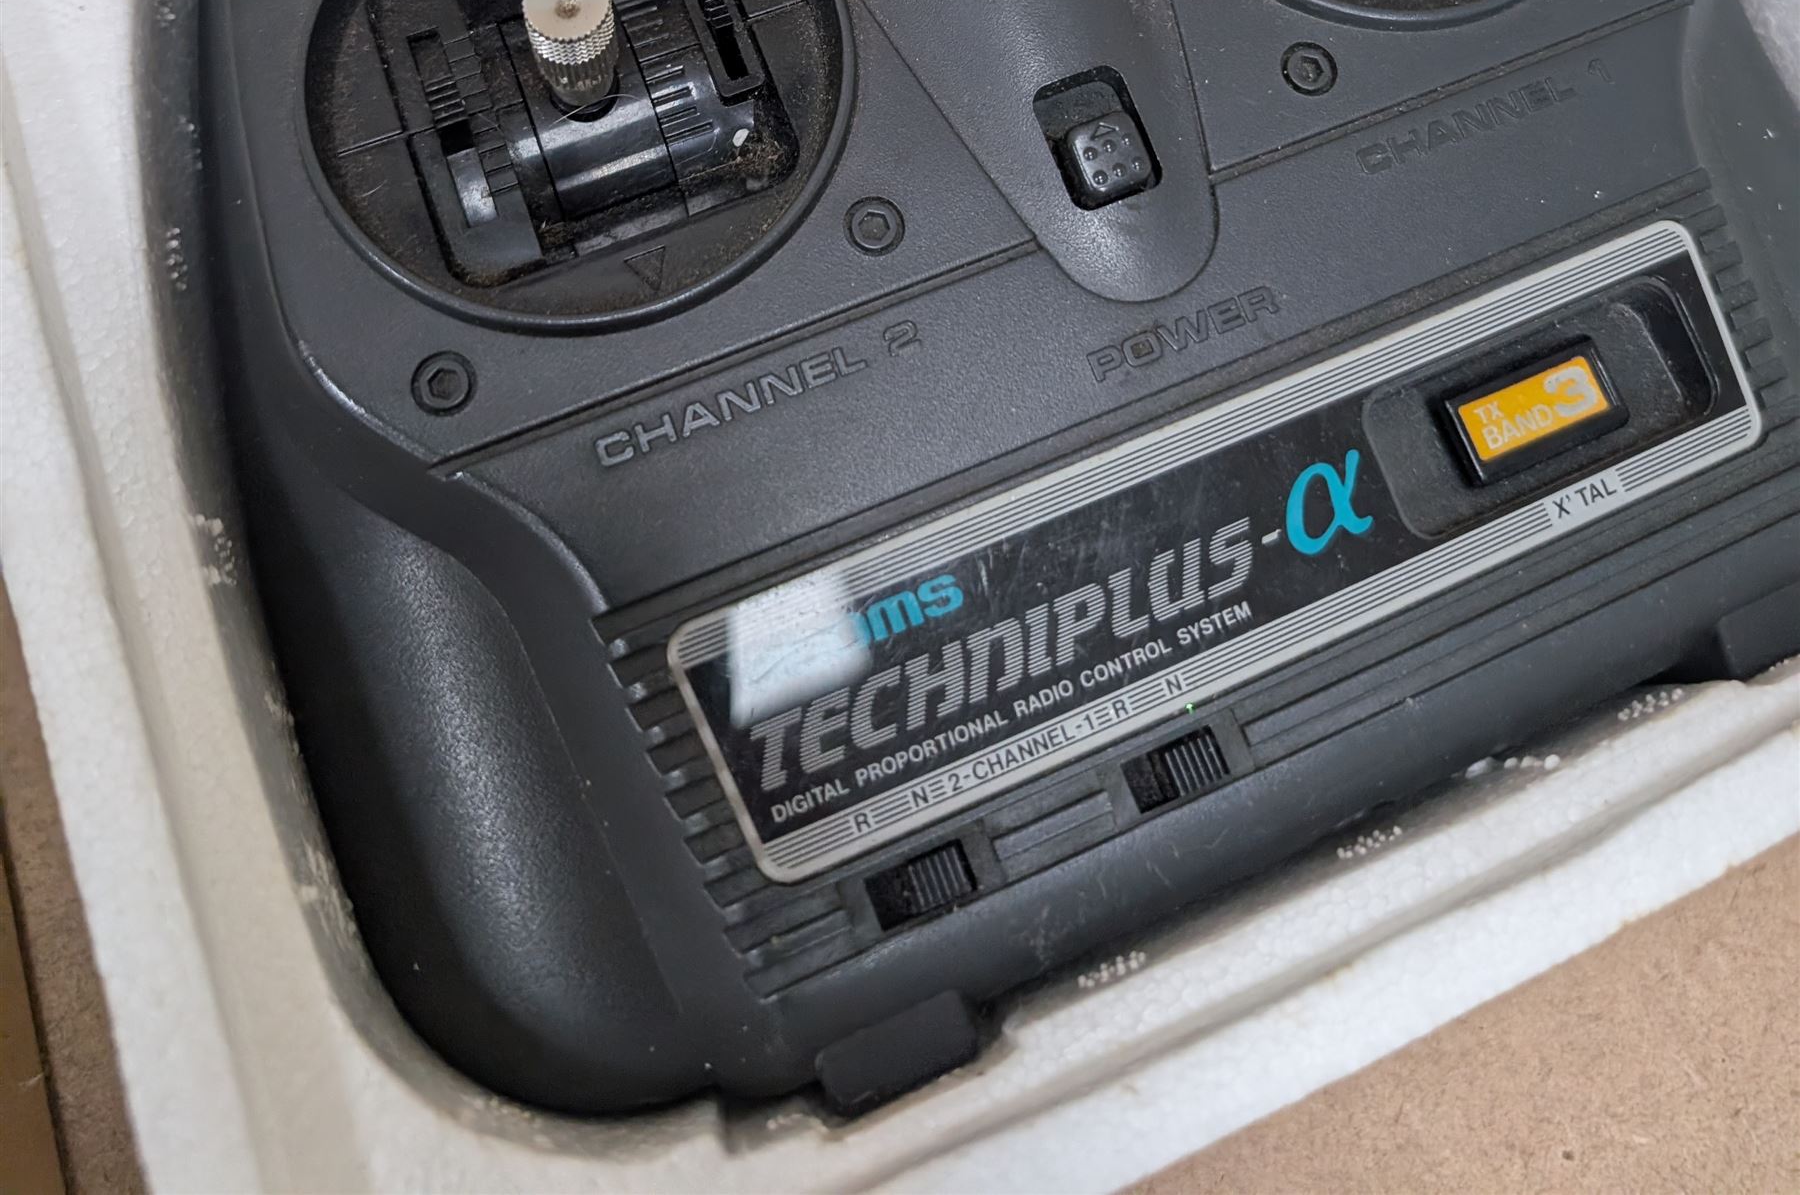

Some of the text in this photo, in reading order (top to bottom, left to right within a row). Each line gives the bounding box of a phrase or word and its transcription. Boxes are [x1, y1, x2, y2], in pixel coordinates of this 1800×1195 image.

[1355, 58, 1615, 175] CHANNEL 1
[1086, 285, 1280, 383] POWER
[594, 319, 922, 468] CHANNEL 2
[1474, 401, 1505, 424] TX
[1482, 365, 1598, 450] BAND 3
[770, 600, 1252, 824] DIGITAL PROPORTIONAL RADIO CONTROL SYSTEM
[853, 811, 872, 834] R
[911, 788, 930, 810] N
[1112, 698, 1131, 720] R
[1164, 675, 1185, 696] N
